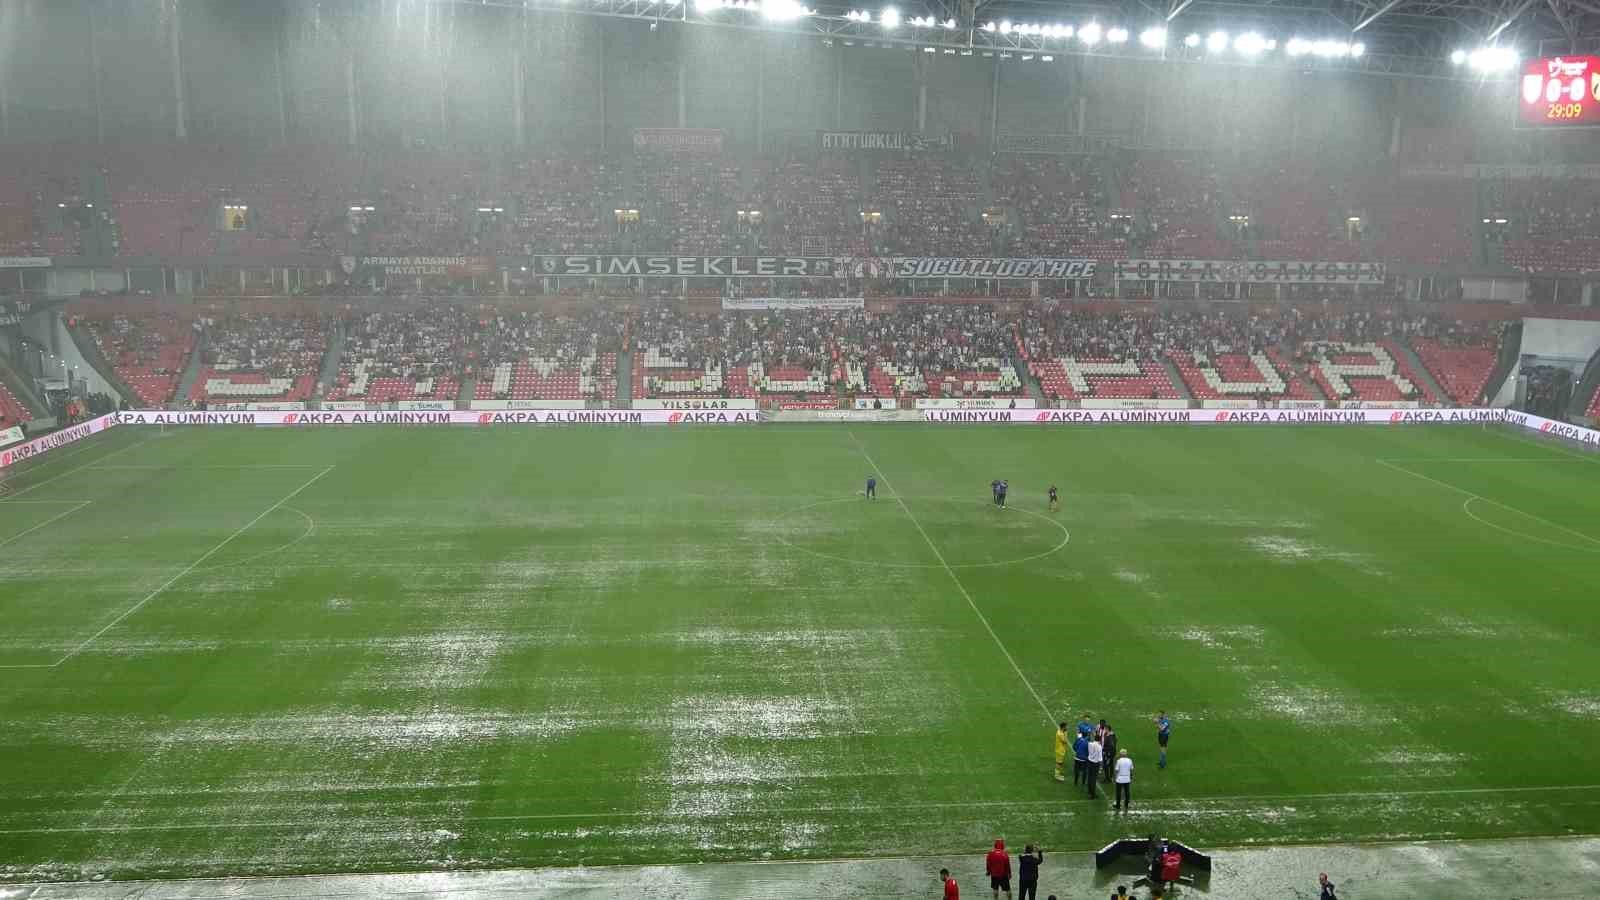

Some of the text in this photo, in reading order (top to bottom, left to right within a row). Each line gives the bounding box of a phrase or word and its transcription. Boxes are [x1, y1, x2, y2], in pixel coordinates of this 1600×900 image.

[1547, 103, 1582, 118] 29:09
[1252, 263, 1385, 281] SAMSUN
[298, 413, 345, 424] AKPA
[494, 412, 538, 423] AKPA
[683, 412, 728, 422] AKPA
[1051, 411, 1094, 421] AKPA
[1228, 411, 1270, 421] AKPA
[1402, 411, 1447, 421] AKPA
[1550, 423, 1579, 440] AKPA
[11, 443, 38, 462] AKPA
